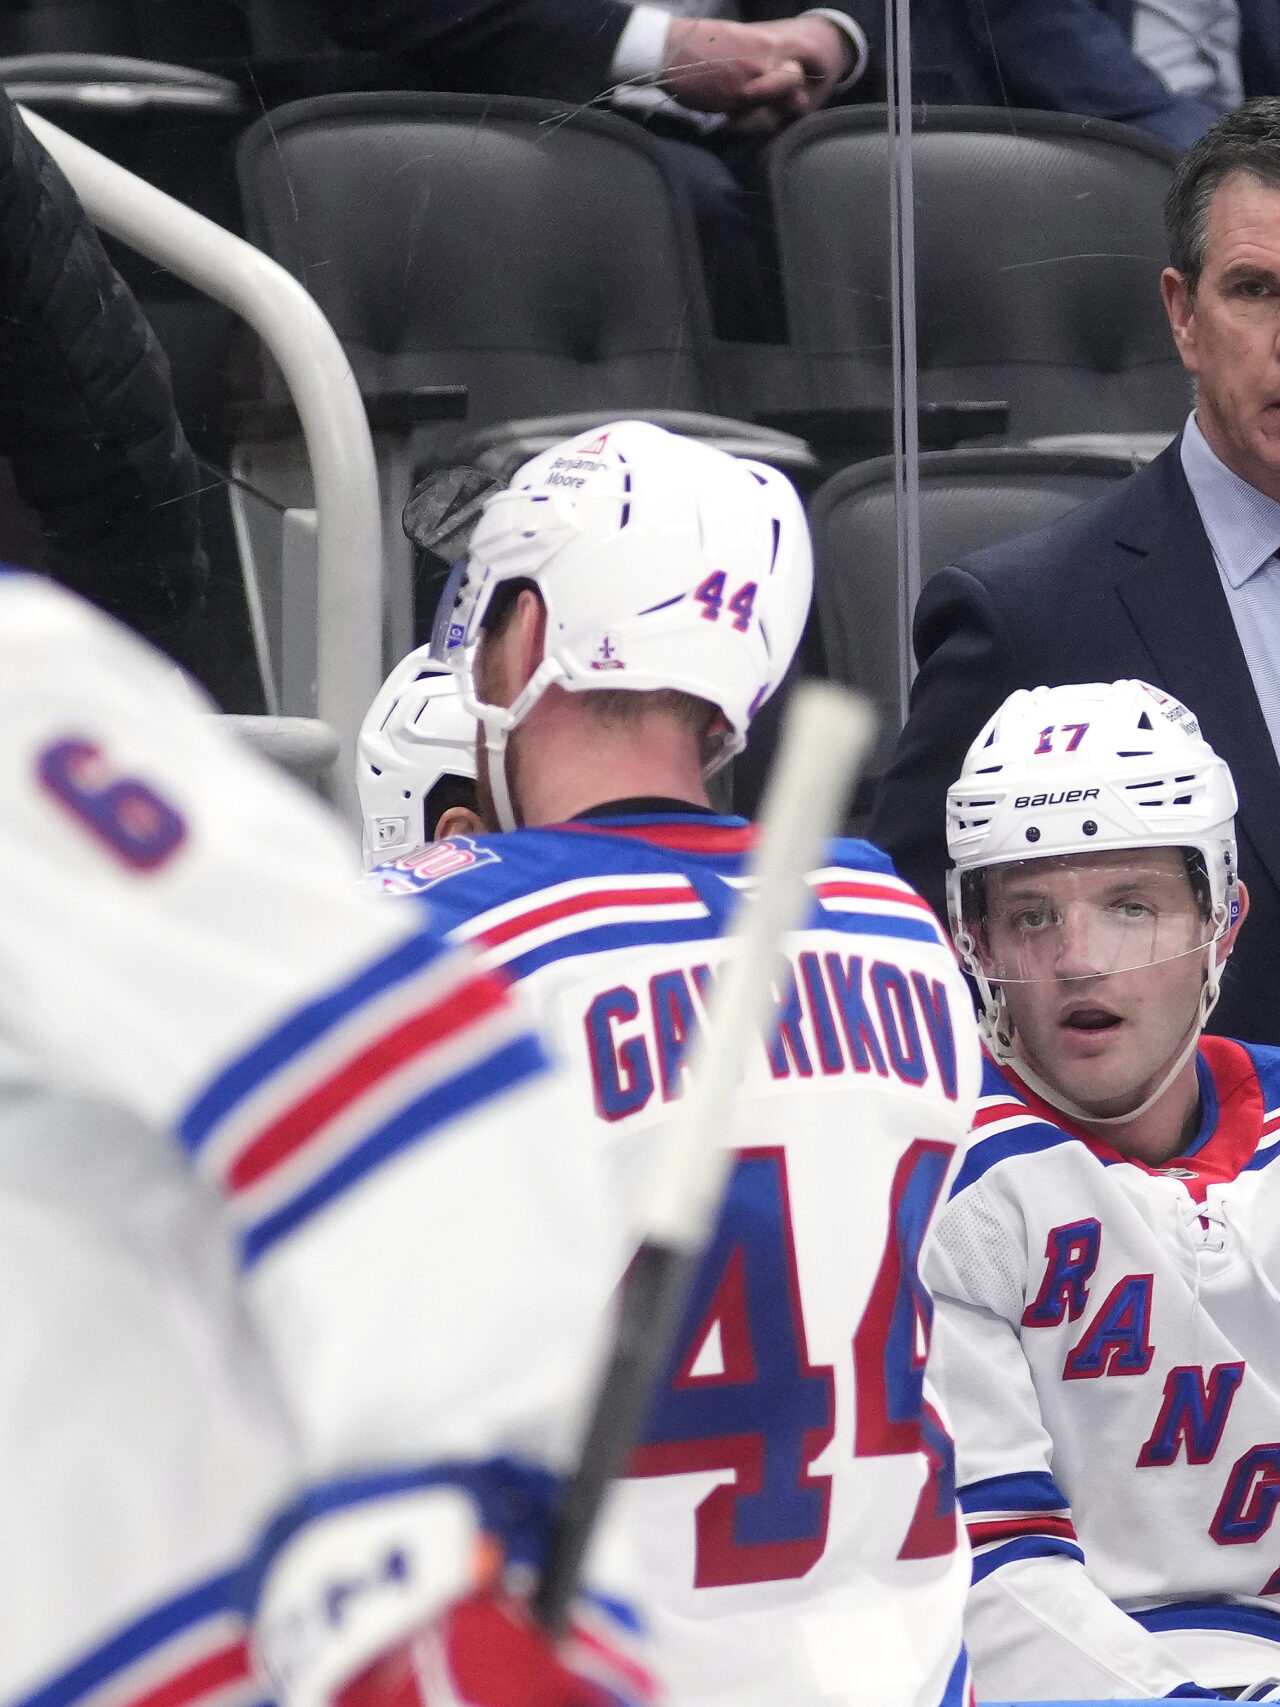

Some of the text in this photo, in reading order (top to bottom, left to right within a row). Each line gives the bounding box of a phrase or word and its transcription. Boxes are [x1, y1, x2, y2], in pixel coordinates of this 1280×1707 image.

[544, 472, 586, 489] Moore
[694, 569, 758, 633] 44
[1033, 722, 1090, 755] 17
[1013, 788, 1100, 809] BAUER
[610, 1138, 958, 1589] 44
